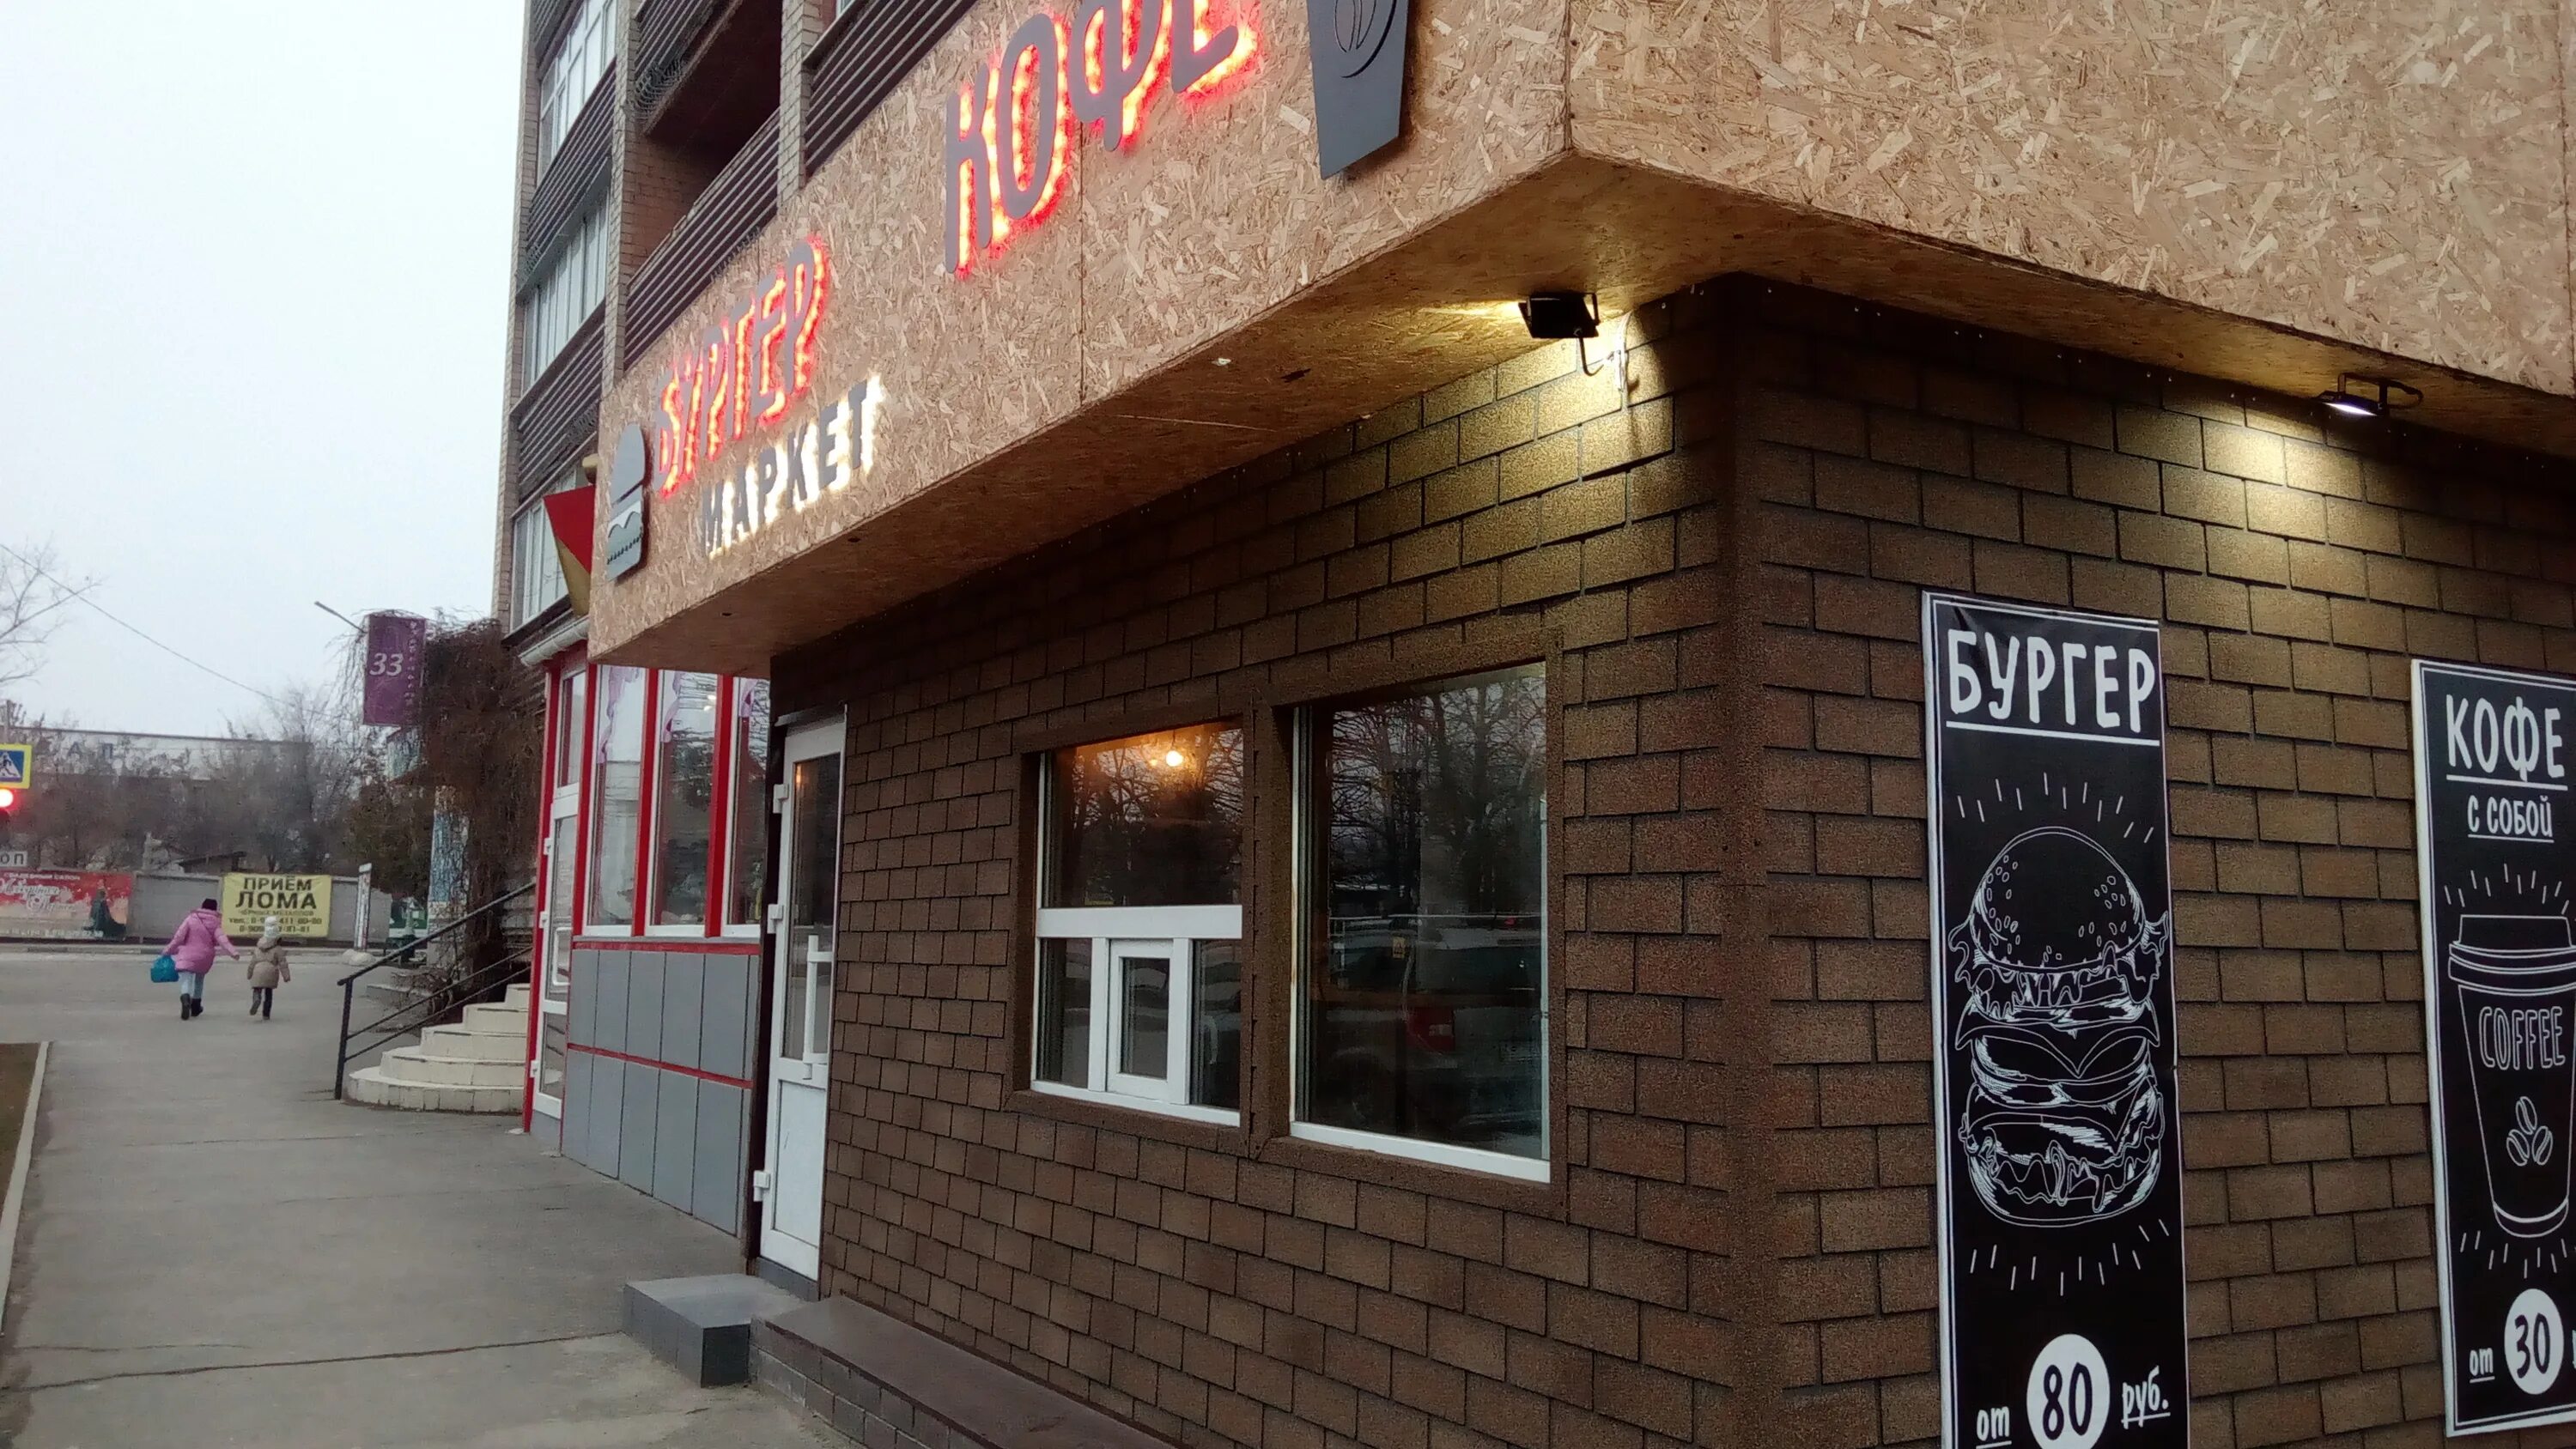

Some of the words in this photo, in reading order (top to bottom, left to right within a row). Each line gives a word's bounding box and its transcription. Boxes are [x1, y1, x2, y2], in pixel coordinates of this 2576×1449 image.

[653, 239, 817, 493] БУРГЕР
[702, 379, 868, 556] МАРКЕТ
[369, 652, 404, 676] 33
[1947, 628, 2155, 733] БУРГЕР
[2446, 694, 2565, 782] КОФЕ
[2467, 794, 2480, 833] С
[2487, 795, 2553, 838] СОБОЙ
[235, 891, 317, 909] ЛОМА
[244, 875, 313, 891] ПРИЁМ
[2479, 1005, 2566, 1070] COFFEE
[2470, 1347, 2494, 1377] от
[2514, 1313, 2551, 1379] 30
[1977, 1406, 2010, 1441] от
[2043, 1361, 2093, 1440] 80
[2123, 1365, 2169, 1430] руб.
